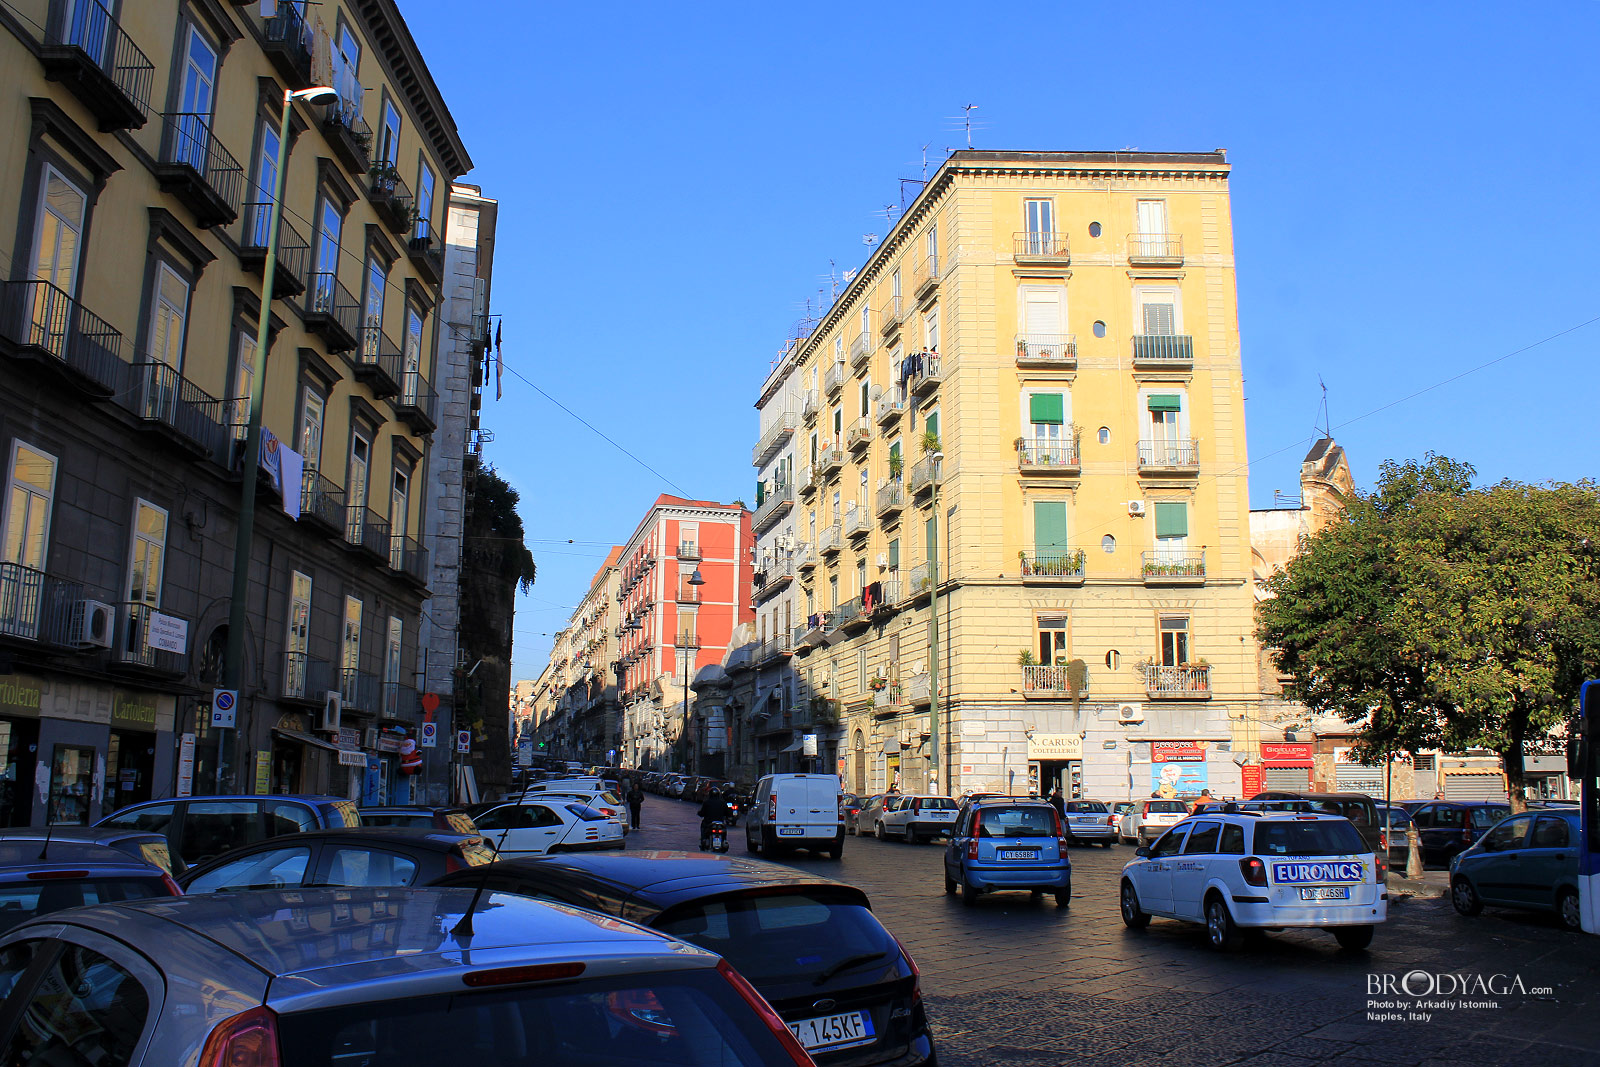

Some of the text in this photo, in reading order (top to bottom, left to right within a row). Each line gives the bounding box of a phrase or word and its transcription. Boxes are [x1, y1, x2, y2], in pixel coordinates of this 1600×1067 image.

[158, 638, 177, 650] COMANDO
[114, 693, 155, 722] Cartoleria
[1277, 862, 1360, 880] EURONICS
[810, 1014, 861, 1044] 145KF
